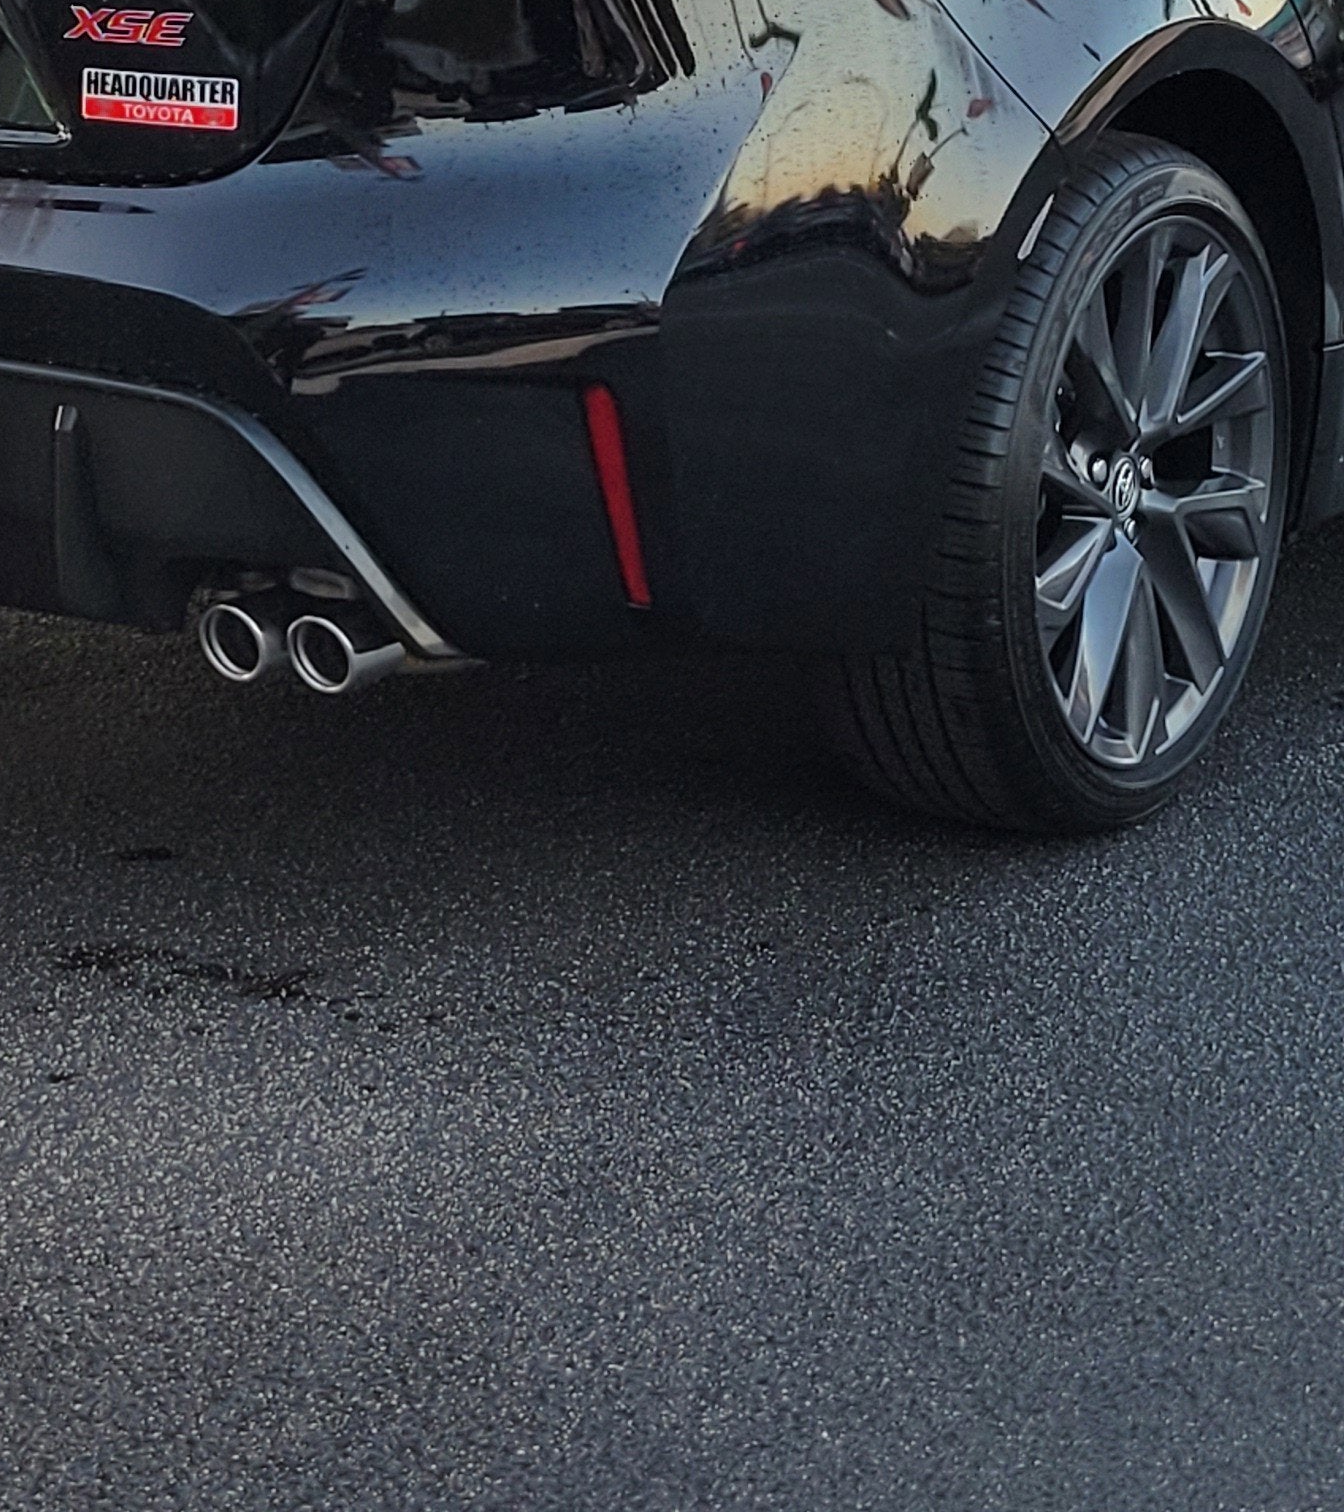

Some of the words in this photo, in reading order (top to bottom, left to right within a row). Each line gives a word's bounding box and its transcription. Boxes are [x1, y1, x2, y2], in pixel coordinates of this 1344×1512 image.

[63, 4, 194, 46] XSE
[86, 71, 235, 105] HEADQUARTER
[122, 103, 194, 123] TOYOTA
